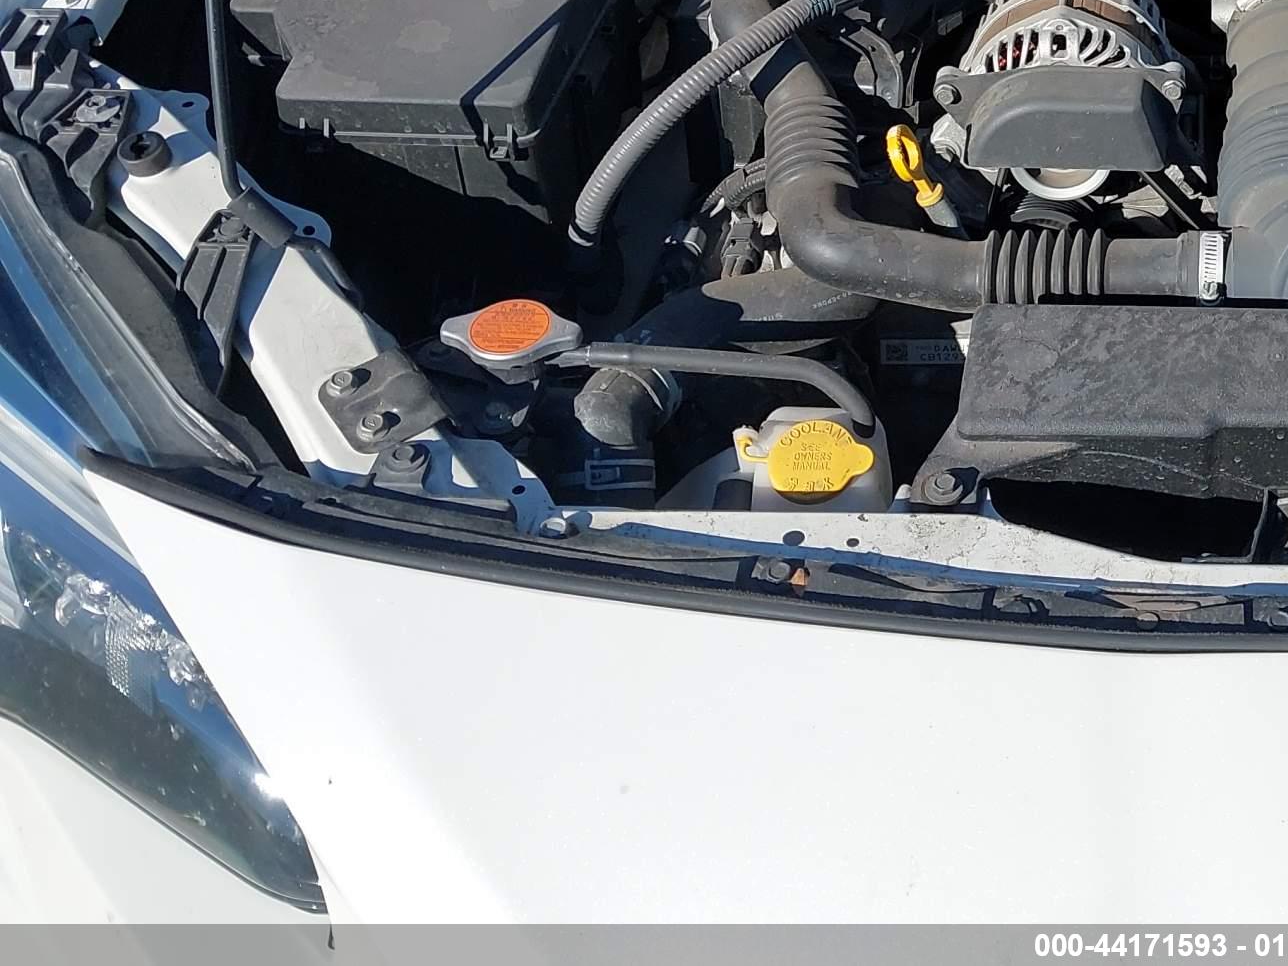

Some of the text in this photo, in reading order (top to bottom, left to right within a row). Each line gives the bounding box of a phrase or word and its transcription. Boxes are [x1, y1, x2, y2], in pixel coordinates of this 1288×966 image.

[800, 442, 822, 452] SEE
[794, 451, 833, 461] OWNERS
[792, 461, 832, 471] MANUAL
